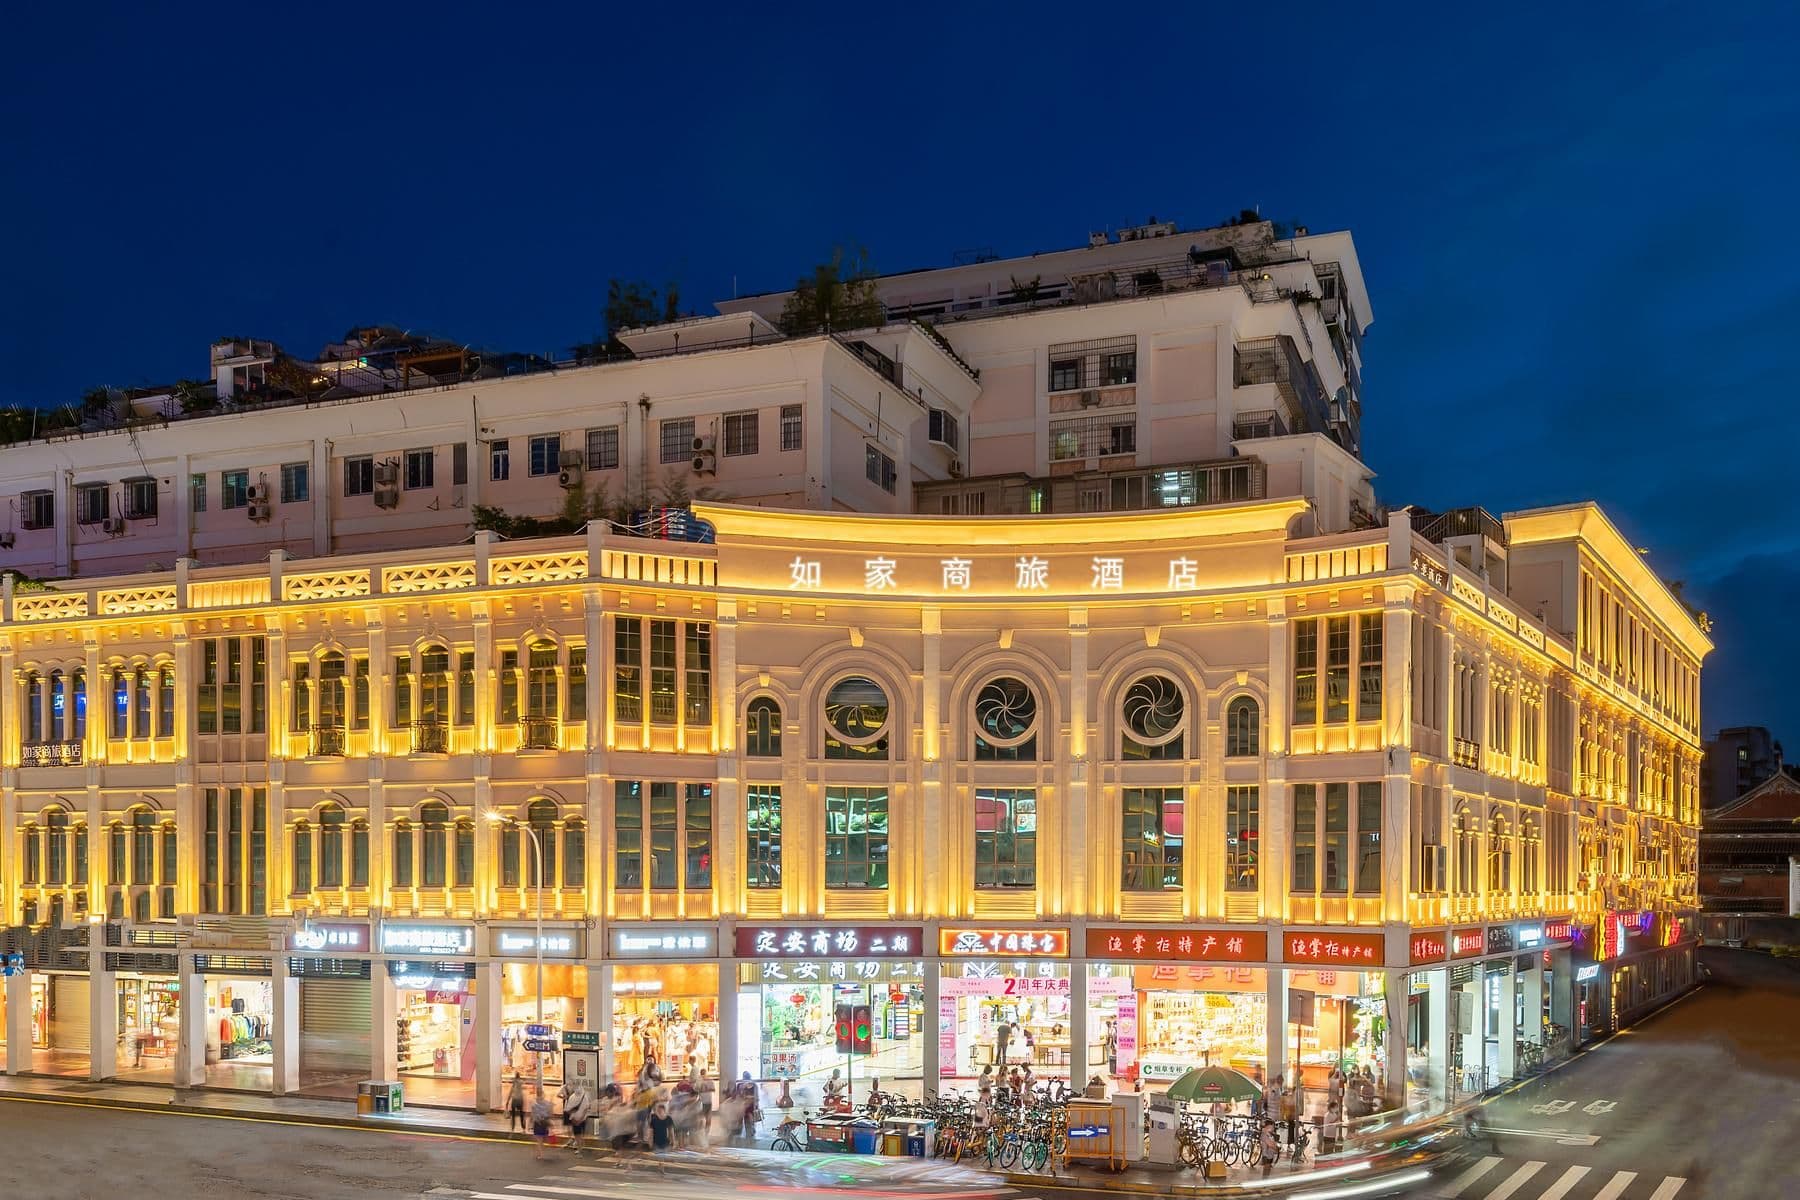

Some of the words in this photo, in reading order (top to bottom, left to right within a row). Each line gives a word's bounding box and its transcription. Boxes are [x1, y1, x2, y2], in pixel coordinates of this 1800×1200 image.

[789, 556, 1199, 591] 如家商旅酒店
